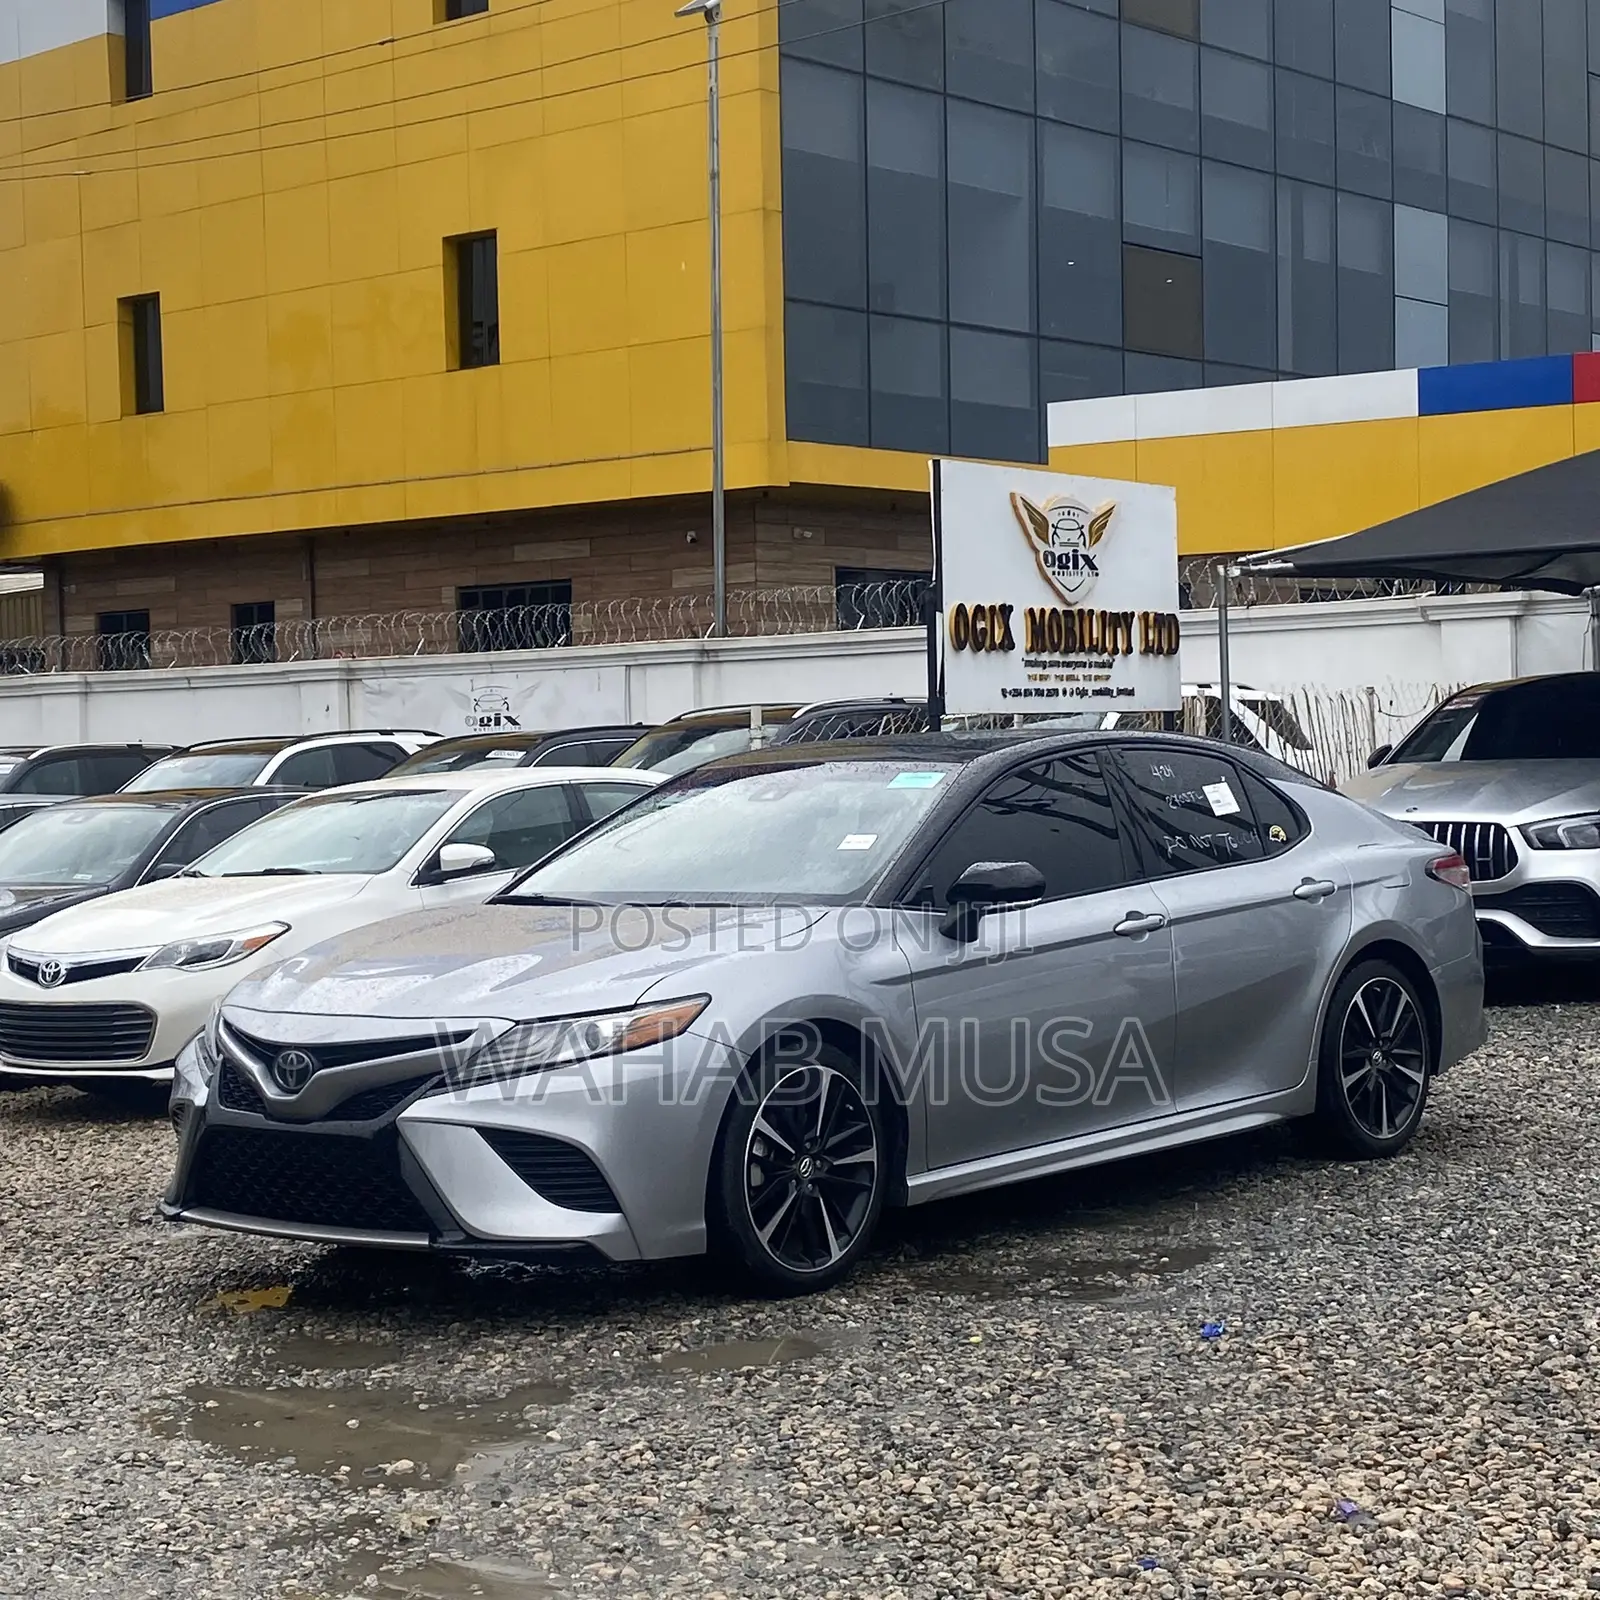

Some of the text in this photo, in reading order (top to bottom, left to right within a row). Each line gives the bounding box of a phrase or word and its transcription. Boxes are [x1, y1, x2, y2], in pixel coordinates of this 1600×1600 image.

[950, 602, 1181, 656] OGIX MOBILITY LTD
